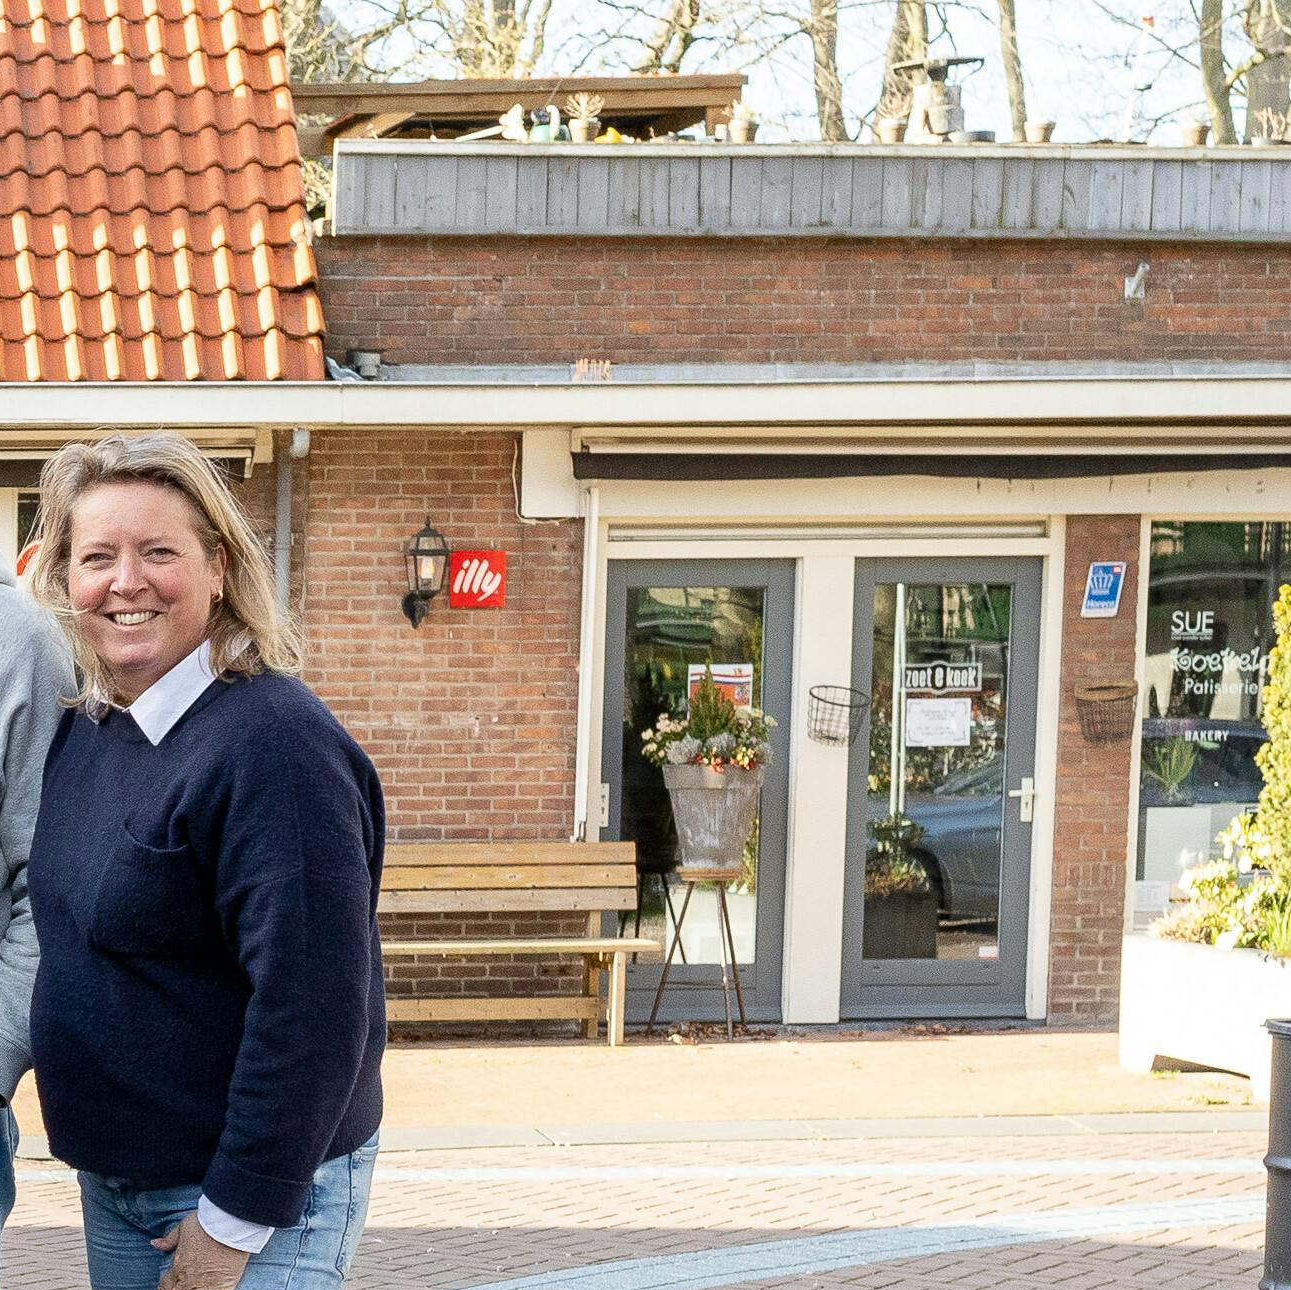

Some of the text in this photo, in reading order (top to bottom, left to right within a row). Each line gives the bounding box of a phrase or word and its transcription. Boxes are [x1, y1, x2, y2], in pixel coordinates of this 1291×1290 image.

[453, 558, 502, 602] illy
[1171, 610, 1214, 634] SUE
[1184, 678, 1259, 695] Patisserie
